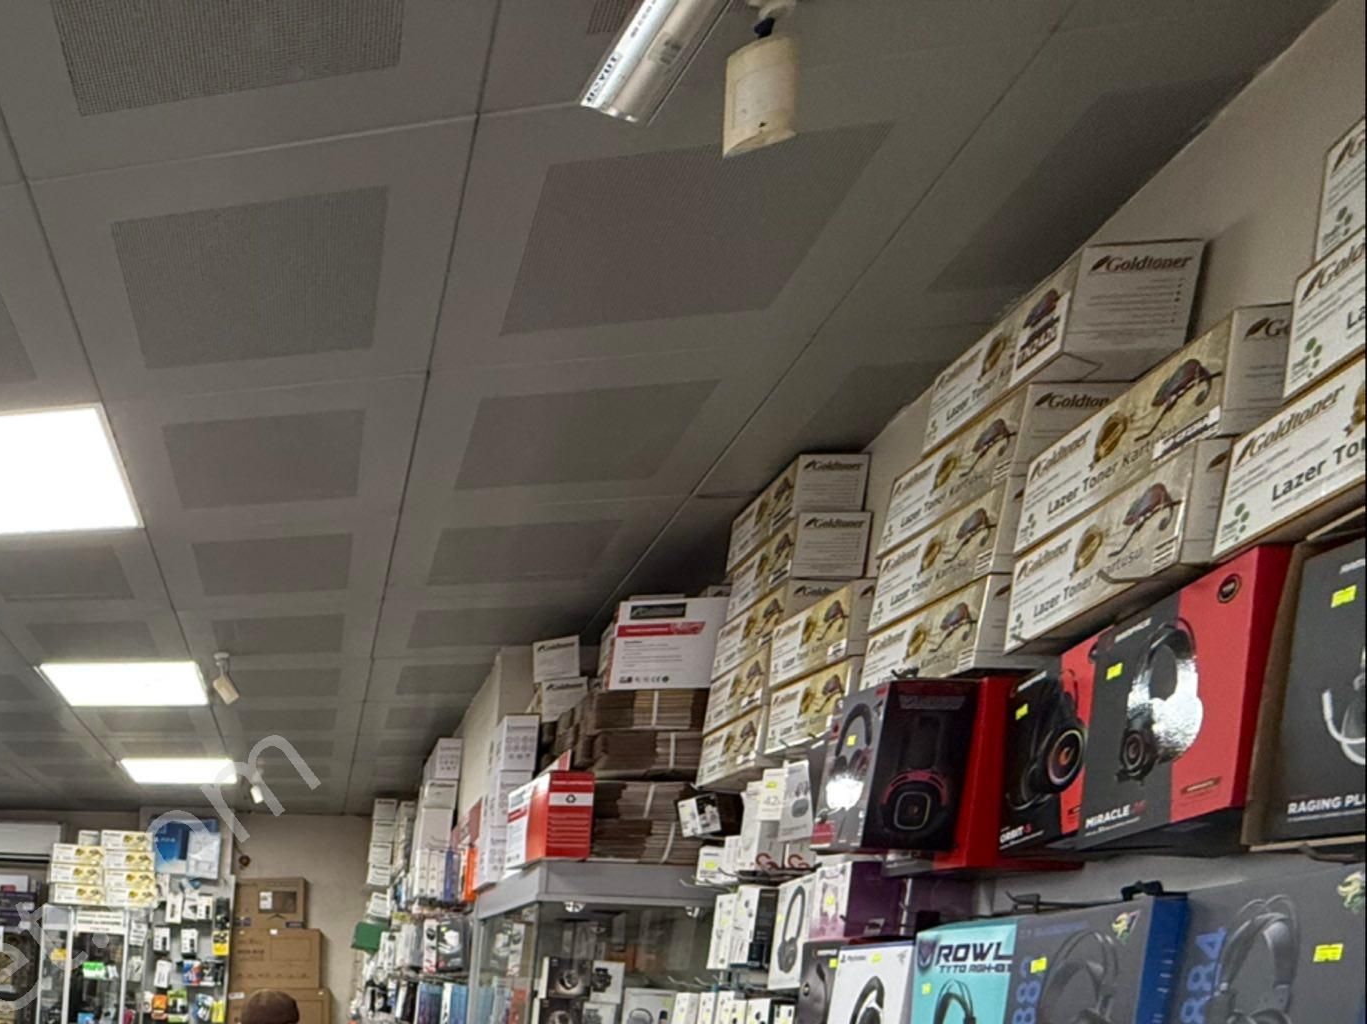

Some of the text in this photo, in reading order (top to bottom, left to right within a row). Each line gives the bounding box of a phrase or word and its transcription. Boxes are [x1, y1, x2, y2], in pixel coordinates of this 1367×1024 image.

[1105, 255, 1193, 273] Goldtoner
[1249, 384, 1346, 459] Goldtoner
[1038, 429, 1091, 475] Goldtoner
[1048, 486, 1078, 516] Lazer
[1082, 458, 1119, 492] Toner
[1272, 459, 1328, 501] Lazer
[900, 509, 921, 528] Lazer
[1034, 593, 1059, 617] Lazer
[1063, 574, 1092, 600] Toner
[1086, 803, 1131, 829] MIRACLE
[1287, 797, 1342, 815] RAGING
[938, 963, 967, 973] TYTO
